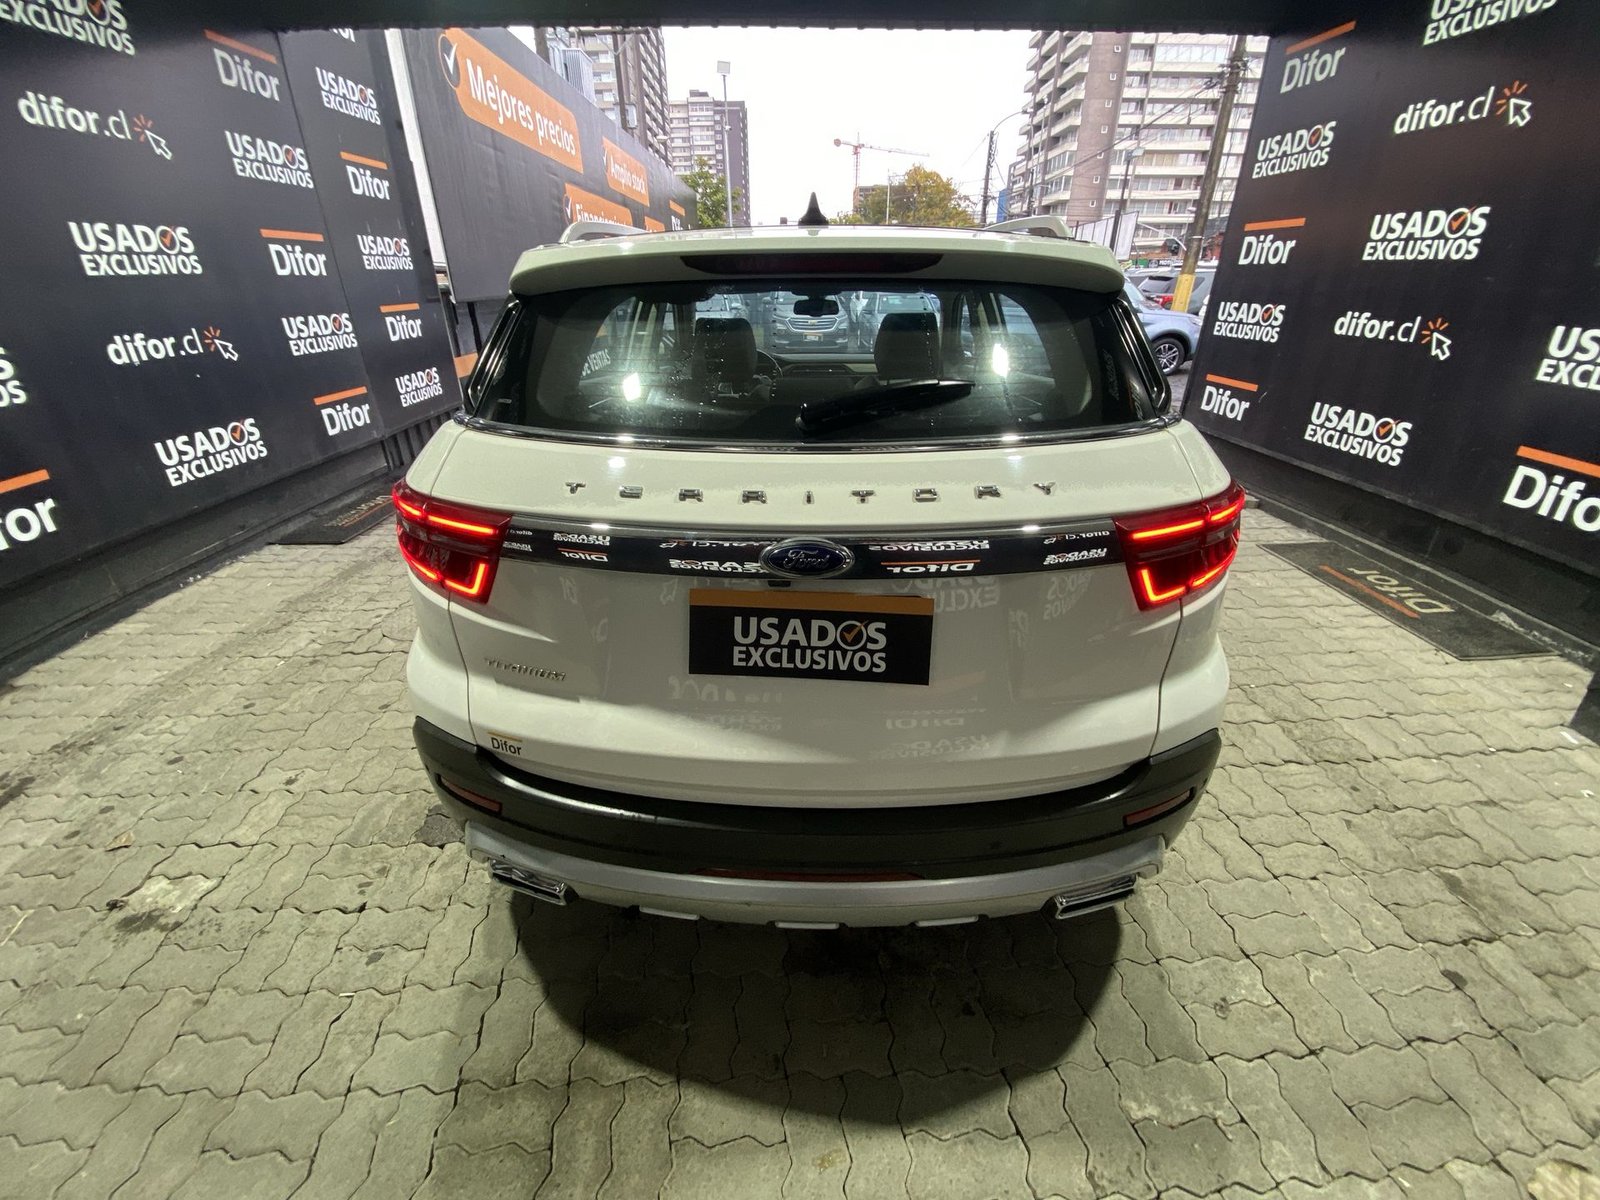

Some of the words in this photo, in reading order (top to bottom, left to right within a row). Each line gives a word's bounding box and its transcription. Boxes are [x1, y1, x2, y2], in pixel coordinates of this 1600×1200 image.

[214, 48, 280, 101] Difor
[1280, 47, 1346, 94] Difor
[315, 67, 377, 109] USADOS
[18, 91, 132, 140] difor.cl
[320, 90, 381, 125] EXCLUSIVOS
[465, 58, 534, 131] Mejores
[534, 111, 576, 156] precios
[1394, 86, 1495, 134] difor.cl
[225, 131, 308, 171] USADOS
[1257, 121, 1336, 161] USADOS
[233, 158, 314, 189] EXCLUSIVOS
[1252, 148, 1330, 179] EXCLUSIVOS
[346, 165, 390, 200] Difor
[68, 221, 194, 254] USADOS
[1370, 206, 1491, 240] USADOS
[268, 244, 327, 276] Difor
[357, 234, 410, 257] USADOS
[1238, 234, 1296, 265] Difor
[1362, 238, 1481, 260] EXCLUSIVOS
[80, 254, 202, 276] EXCLUSIVOS
[363, 255, 413, 271] EXCLUSIVOS
[281, 313, 353, 339] USADOS
[385, 317, 423, 341] Difor
[1218, 301, 1286, 326] USADOS
[1334, 311, 1421, 343] difor.cl
[107, 328, 203, 365] difor.cl
[289, 333, 358, 356] EXCLUSIVOS
[1213, 322, 1280, 343] EXCLUSIVOS
[395, 367, 440, 394] USADOS
[400, 382, 442, 408] EXCLUSIVOS
[321, 403, 370, 436] Difor
[1201, 386, 1250, 421] Difor
[1311, 402, 1412, 447] USADOS
[154, 418, 260, 466] USADOS
[1304, 425, 1404, 467] EXCLUSIVOS
[165, 440, 267, 487] EXCLUSIVOS
[565, 481, 1056, 504] TERRITORY
[1503, 465, 1600, 532] Difo
[783, 549, 831, 569] Ford
[733, 616, 887, 651] USADOS
[732, 646, 887, 674] EXCLUSIVOS
[490, 736, 522, 756] Difor
